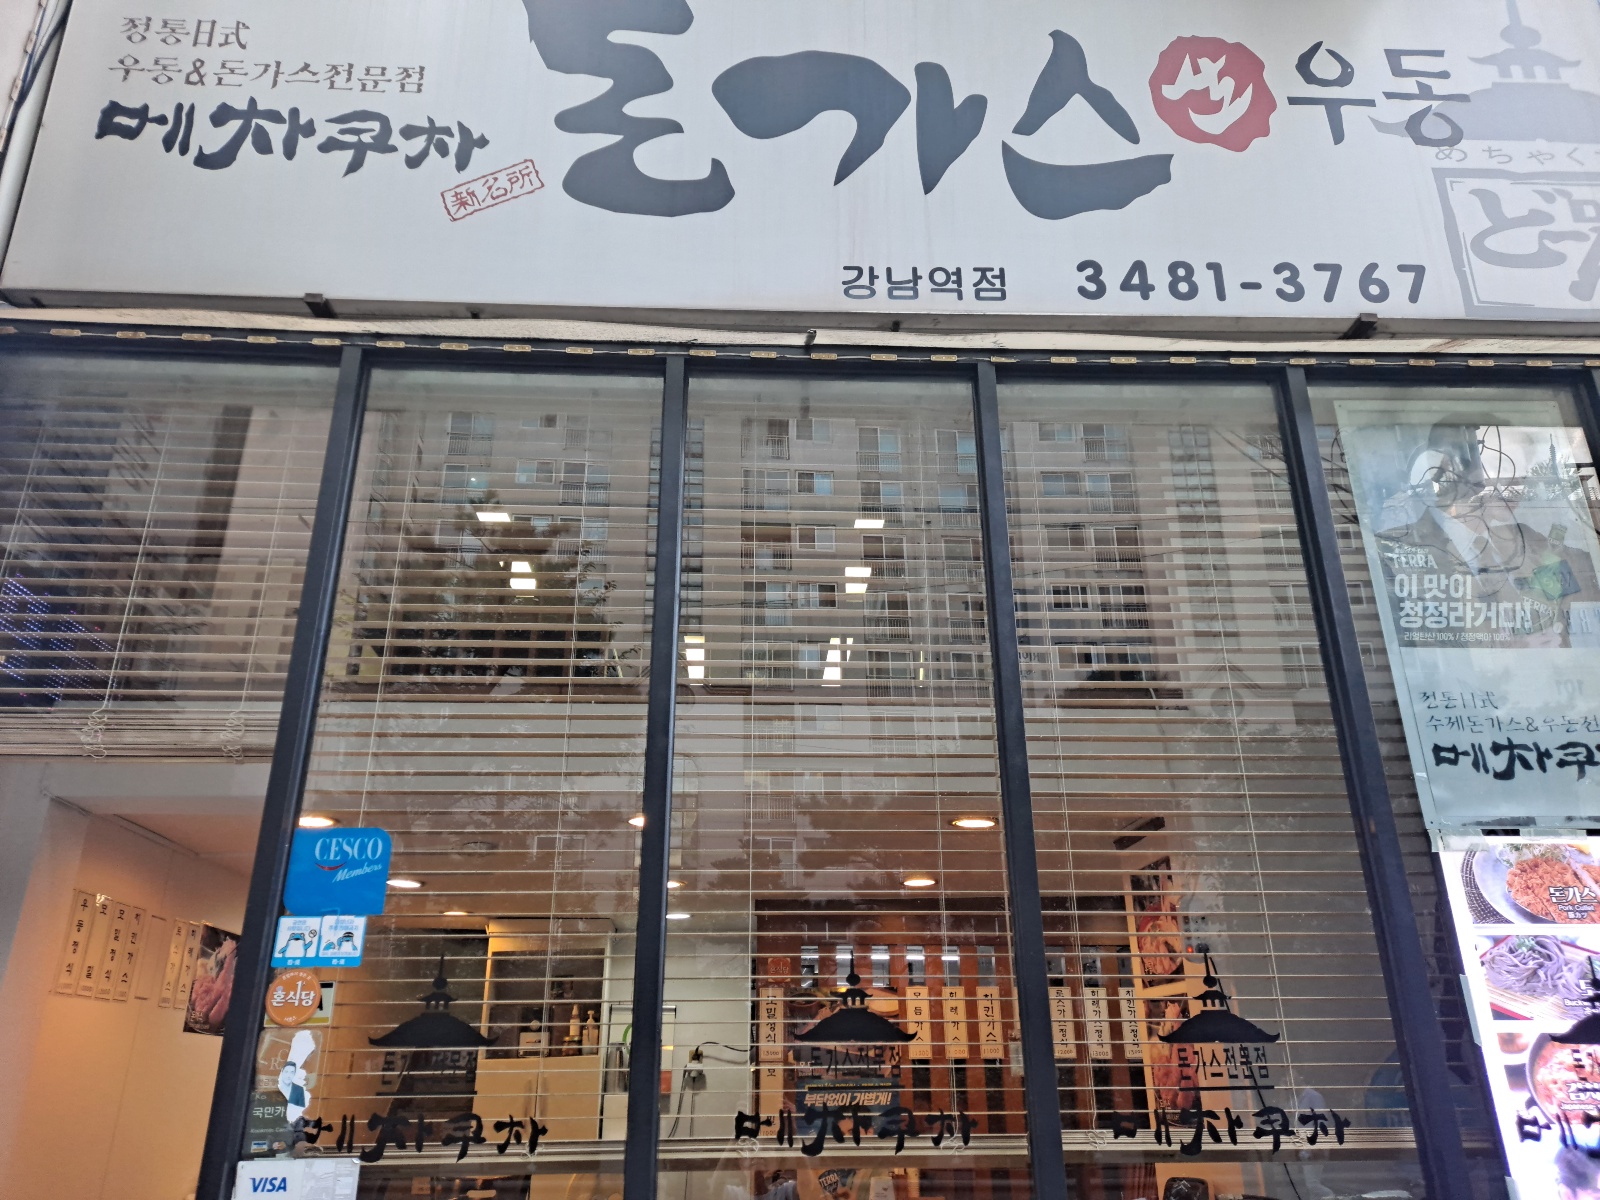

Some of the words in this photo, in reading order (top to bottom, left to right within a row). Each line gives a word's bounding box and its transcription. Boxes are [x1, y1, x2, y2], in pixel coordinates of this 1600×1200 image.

[120, 16, 251, 50] 정통日式
[107, 53, 427, 94] 우동&돈가스전문점
[94, 95, 490, 178] 메차쿠차
[1435, 145, 1600, 168] めちゃく
[841, 264, 1008, 302] 강남역점
[1075, 258, 1427, 305] 3481-3767
[1392, 552, 1439, 569] TERRA
[1394, 573, 1418, 599] 이
[1423, 573, 1472, 600] 맛이
[1398, 601, 1533, 629] 청정라거다!
[1404, 632, 1435, 641] 리얼탄산
[1436, 632, 1455, 641] 100%
[1493, 632, 1511, 641] 100%
[1431, 736, 1600, 782] 메차쿠
[314, 837, 383, 860] CESCO
[331, 862, 383, 883] Members
[1549, 886, 1599, 903] 돈가스
[271, 980, 316, 1007] 혼식당
[1177, 1044, 1270, 1081] 돈가스전문점
[252, 1106, 287, 1119] 국민카
[804, 1092, 850, 1107] 부담없이
[851, 1092, 892, 1106] 가볍게!
[734, 1103, 979, 1157] 메차쿠차
[1112, 1106, 1352, 1156] 메차쿠차
[249, 1176, 287, 1193] VISA
[819, 1174, 840, 1188] TERRA
